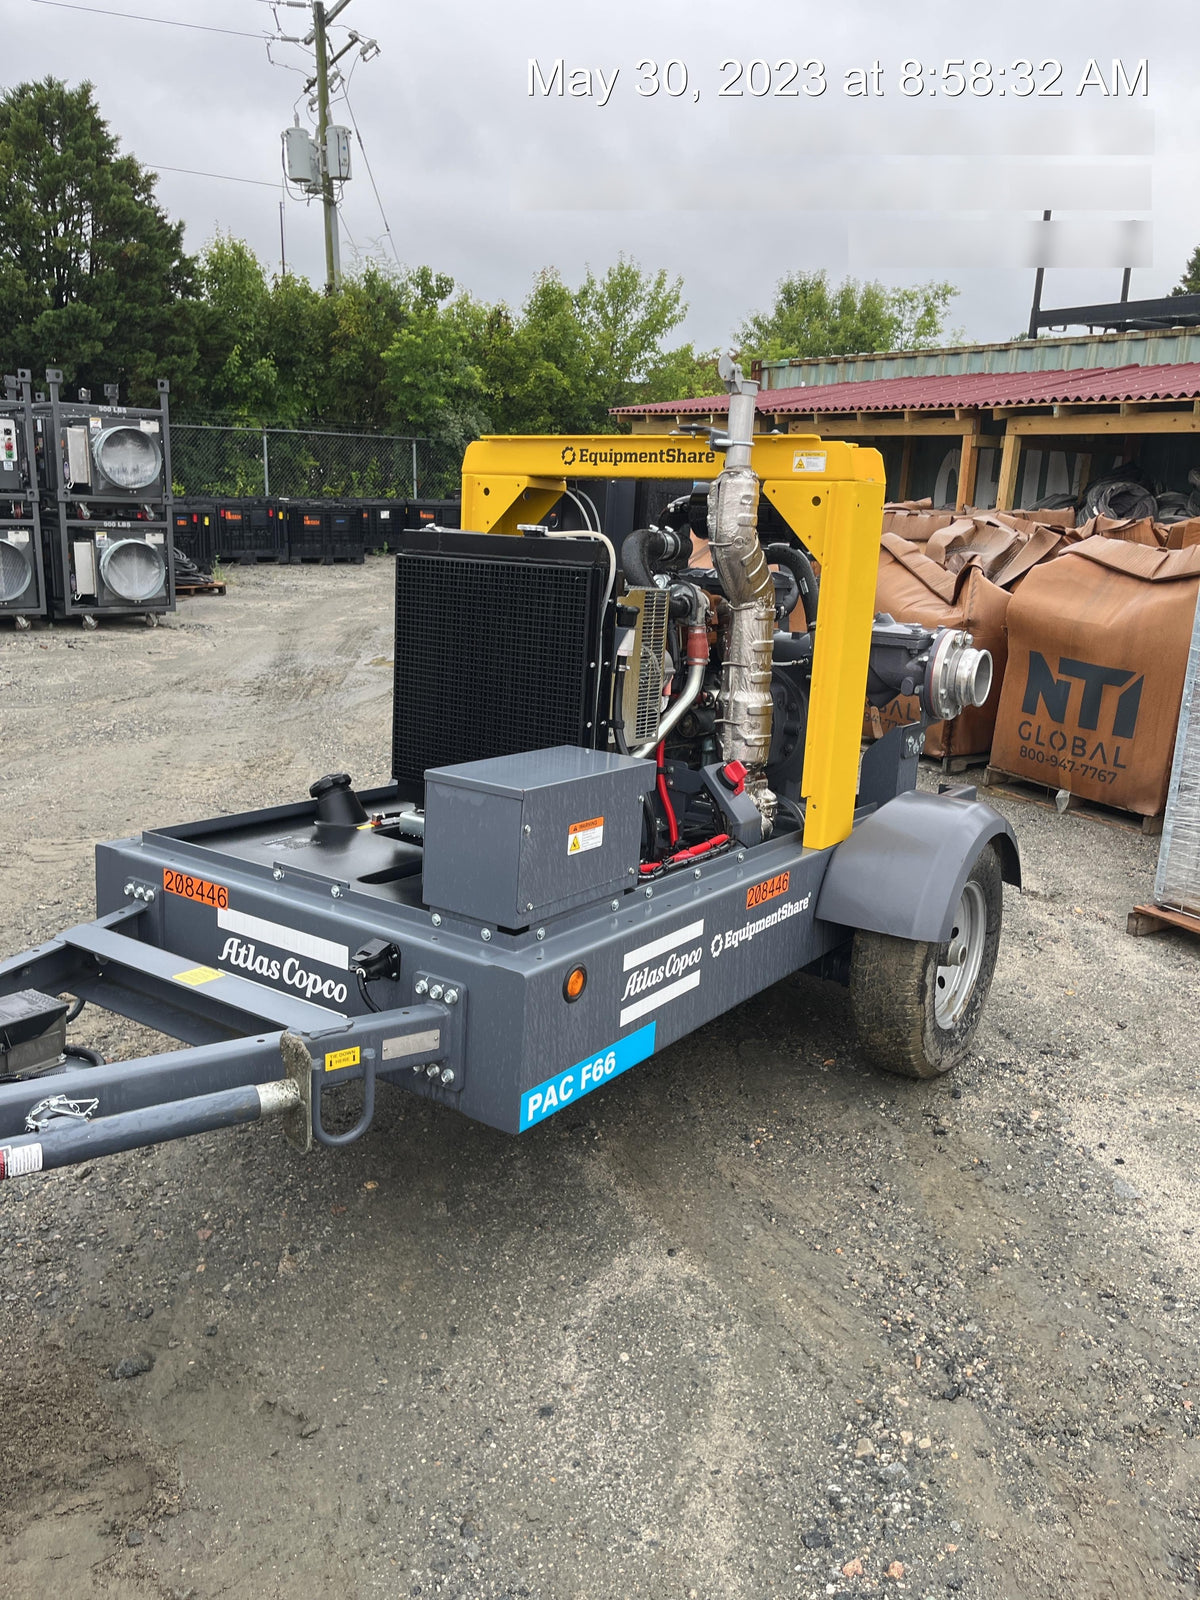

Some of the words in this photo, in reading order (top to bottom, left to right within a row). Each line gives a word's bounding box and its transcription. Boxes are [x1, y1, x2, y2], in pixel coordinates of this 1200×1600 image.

[578, 448, 716, 467] EquipmentShare
[1021, 649, 1145, 740] NTI
[1017, 719, 1127, 770] GLOBAL
[1019, 744, 1118, 785] 800-947-7767
[164, 869, 227, 908] 208446
[746, 871, 789, 907] 208446
[217, 937, 281, 980] Atlas
[281, 957, 348, 1003] Copco
[620, 964, 665, 1002] Atlas
[664, 946, 703, 977] Copco
[339, 1049, 355, 1058] DOWN
[527, 1074, 575, 1122] PAC
[580, 1050, 616, 1091] F66
